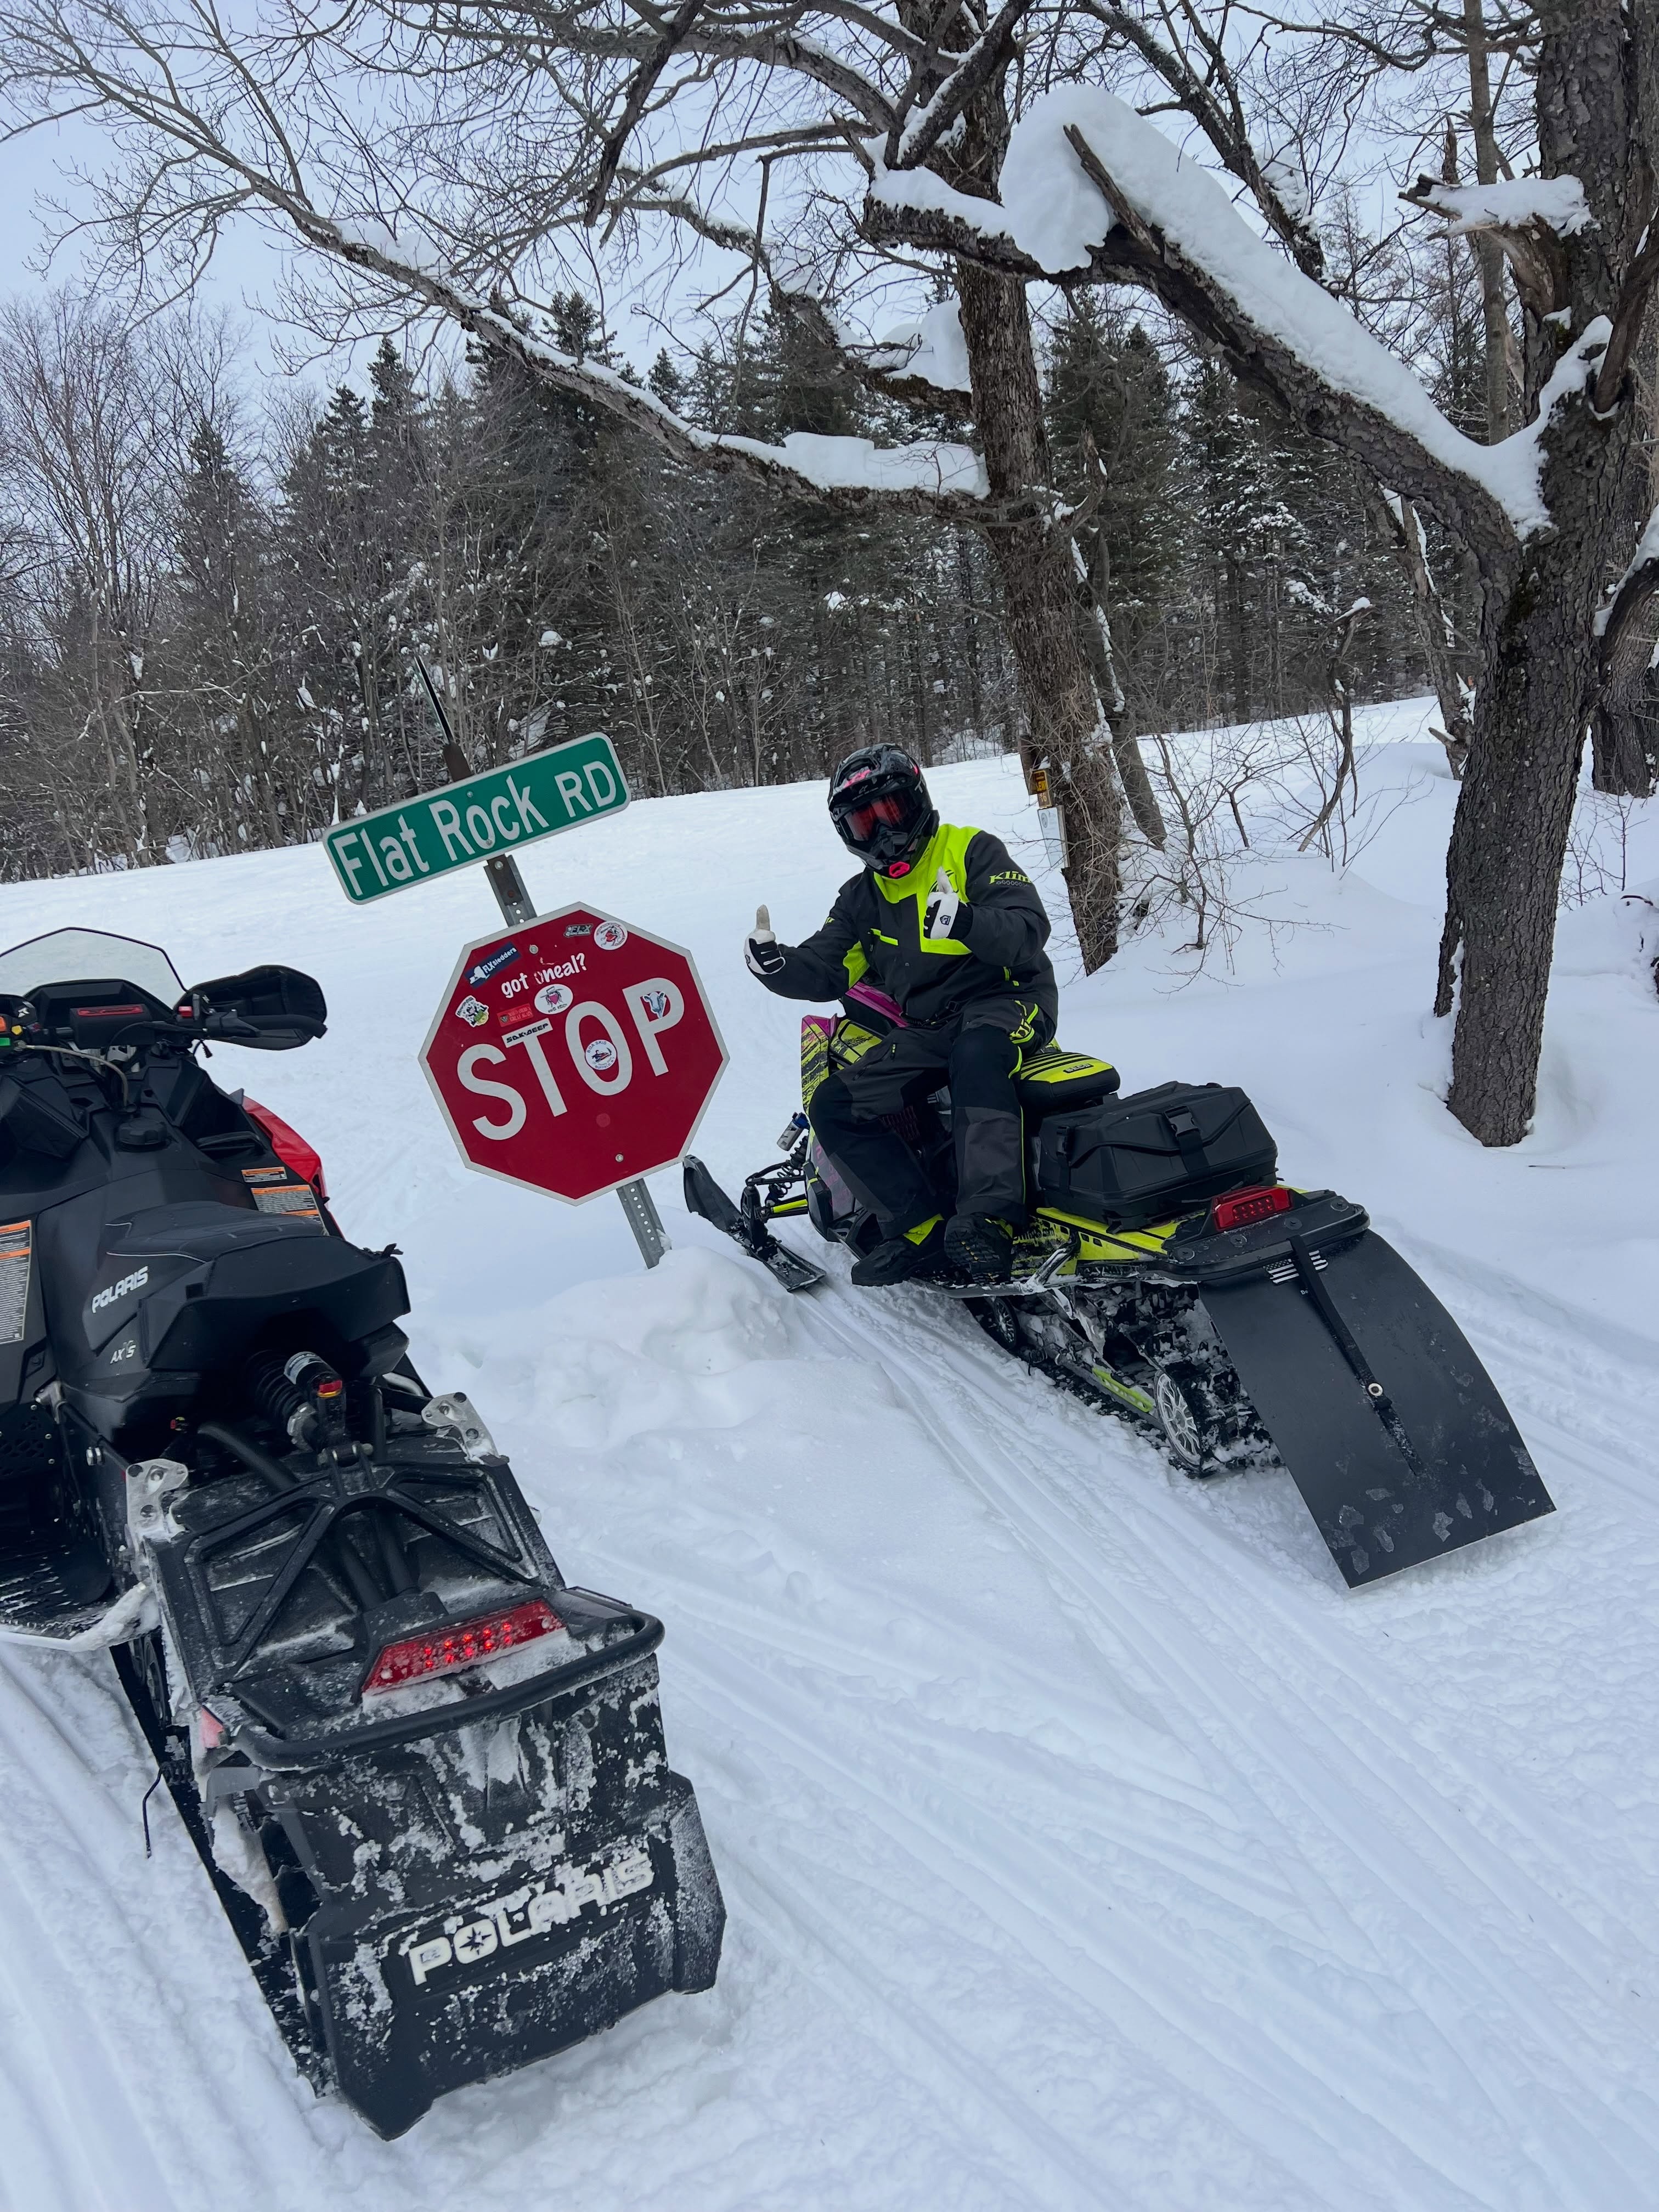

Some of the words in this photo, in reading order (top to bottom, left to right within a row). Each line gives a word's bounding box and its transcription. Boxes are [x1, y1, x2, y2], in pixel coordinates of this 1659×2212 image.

[332, 814, 430, 896] Flat
[428, 775, 550, 862] Rock
[554, 760, 617, 817] RD
[501, 972, 529, 998] got
[456, 977, 685, 1141] STOP
[92, 1266, 149, 1314] POLARIS
[408, 1850, 656, 1986] POLARIS
